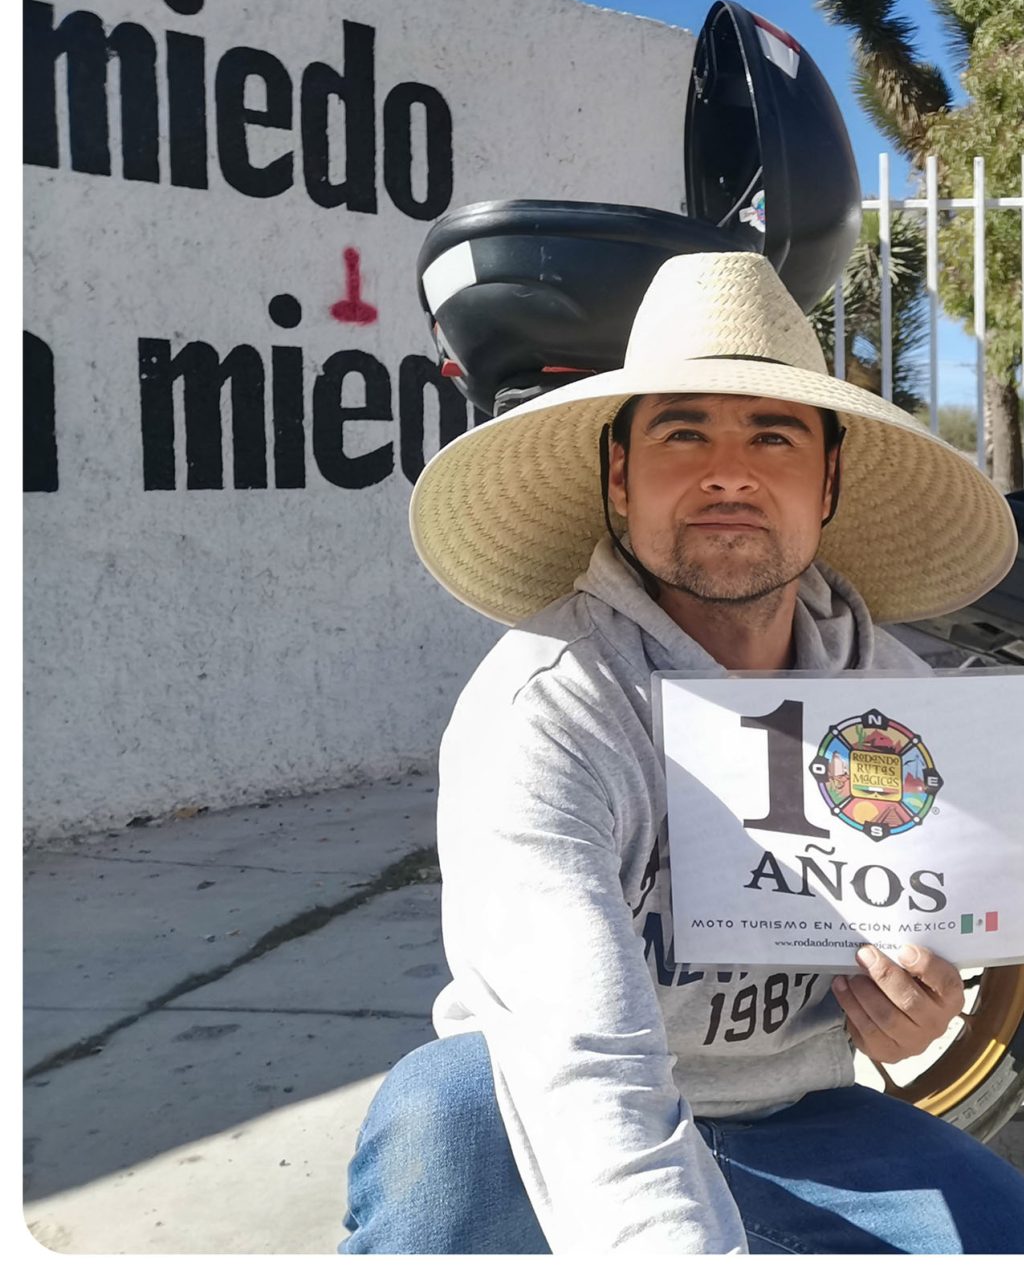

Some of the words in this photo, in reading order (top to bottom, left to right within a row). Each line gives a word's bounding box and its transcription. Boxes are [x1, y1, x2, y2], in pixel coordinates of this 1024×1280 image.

[868, 715, 882, 725] N
[927, 776, 939, 786] E
[870, 825, 883, 837] S
[743, 843, 947, 913] AÑOS
[691, 919, 734, 928] MOTO
[741, 920, 807, 930] TURISMO
[814, 921, 833, 930] EN
[703, 973, 820, 1046] 1987
